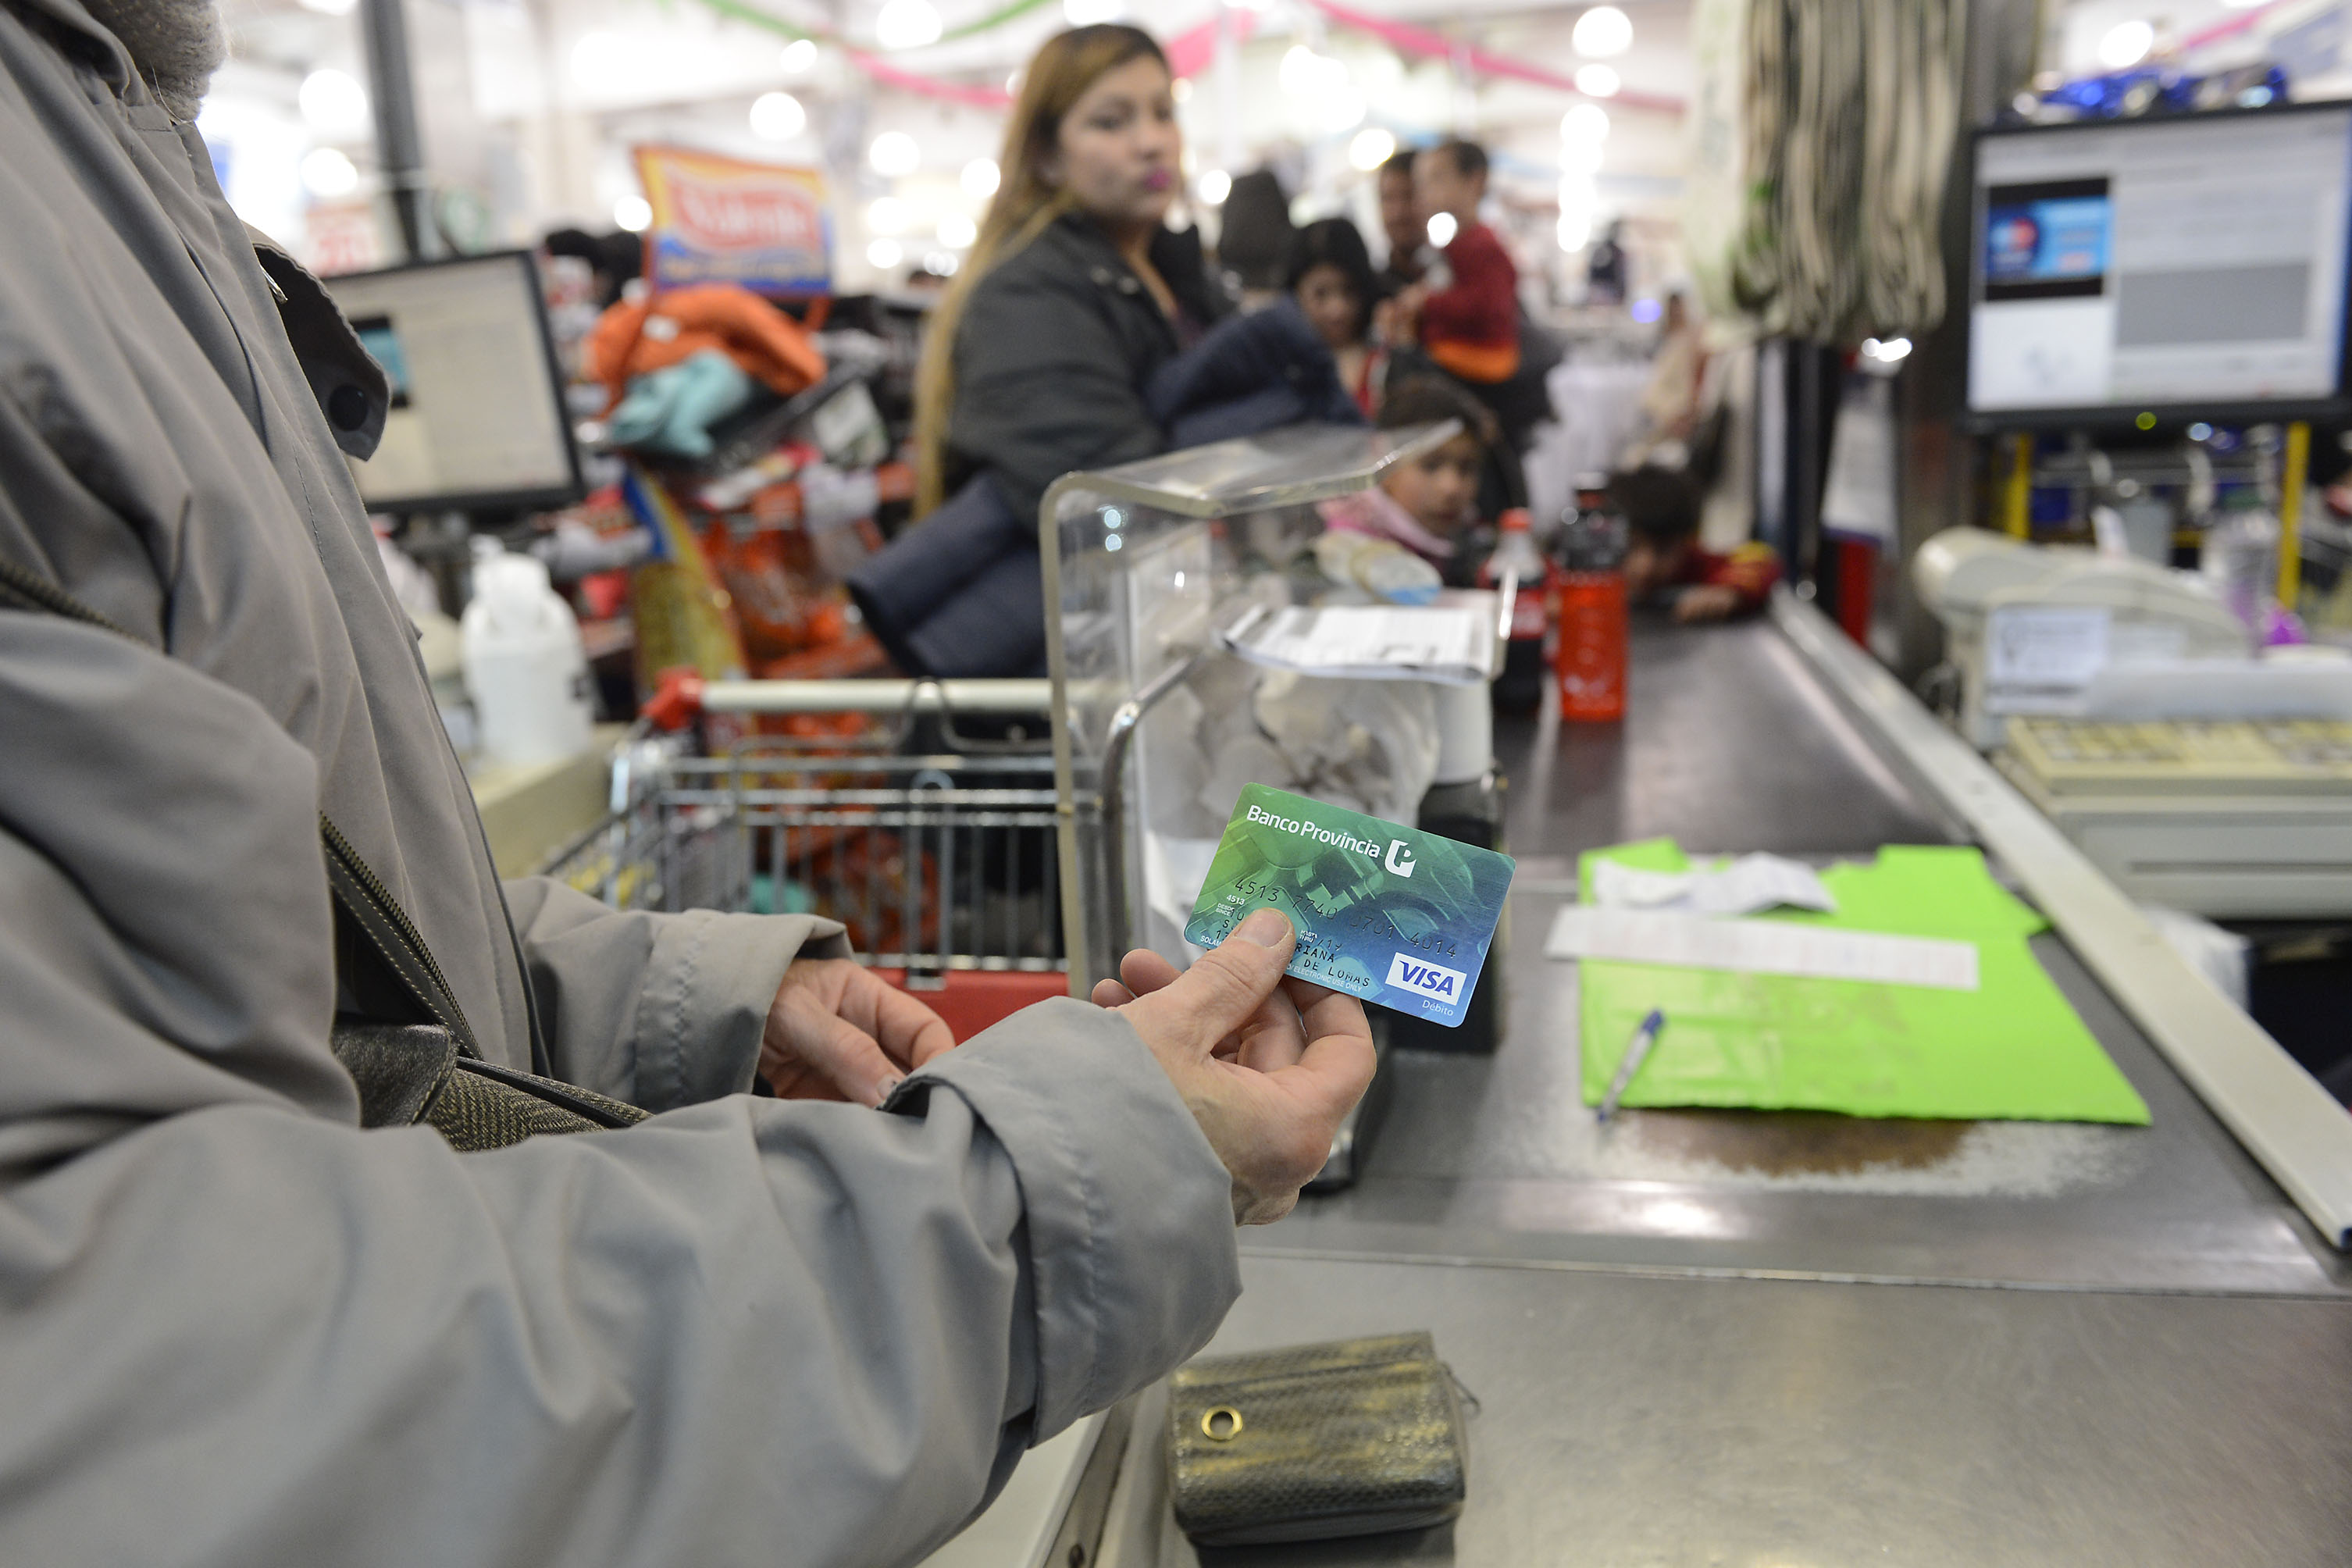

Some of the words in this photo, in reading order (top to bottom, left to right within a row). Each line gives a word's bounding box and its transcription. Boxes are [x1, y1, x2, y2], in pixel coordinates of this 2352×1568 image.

[1246, 804, 1300, 834] Banco
[1300, 820, 1381, 859] Provincia
[1226, 894, 1245, 906] 4513
[1235, 878, 1280, 902] 4513
[1292, 895, 1338, 920] 7740
[1409, 932, 1456, 959] 4014
[1200, 935, 1222, 946] SOLAM
[1295, 943, 1335, 963] RIANA
[1303, 959, 1320, 971] DE
[1293, 965, 1332, 982] ELECTRONIC
[1331, 977, 1345, 986] USE
[1345, 981, 1363, 992] ONLY
[1399, 960, 1455, 996] VISA
[1422, 1000, 1455, 1017] Débito
